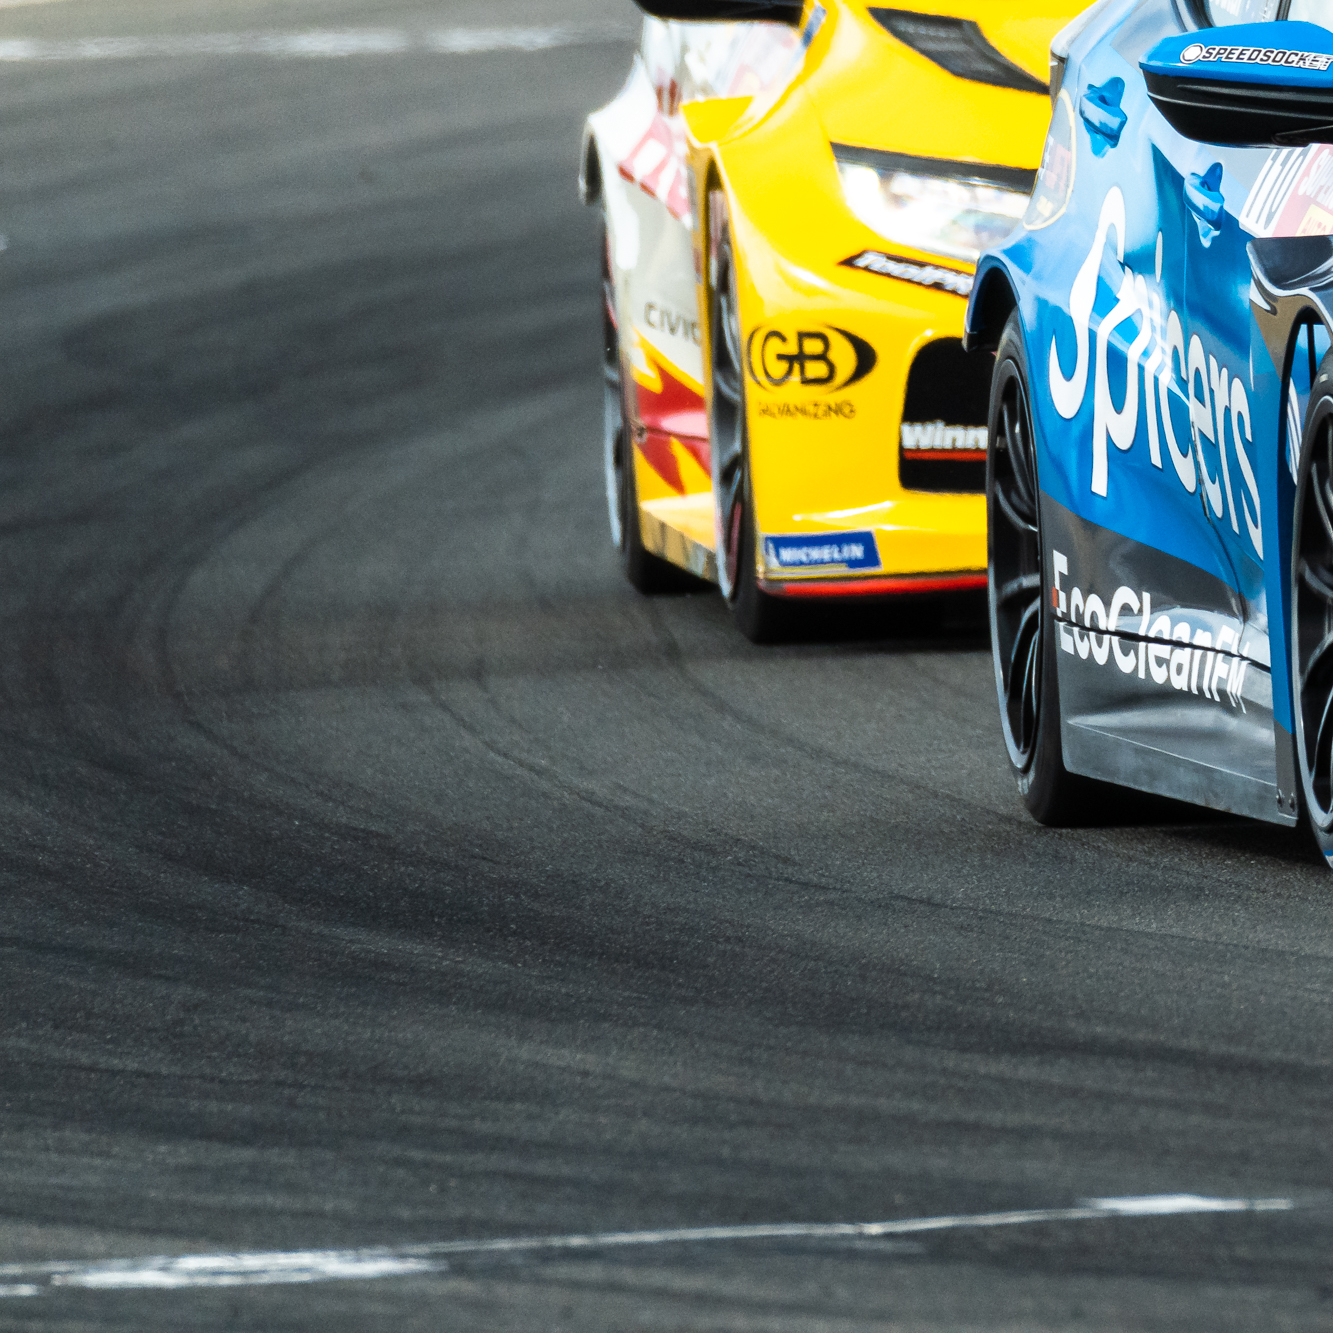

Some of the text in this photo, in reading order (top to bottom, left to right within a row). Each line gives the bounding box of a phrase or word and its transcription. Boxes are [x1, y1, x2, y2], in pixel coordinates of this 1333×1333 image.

[854, 250, 974, 297] ToolPR
[761, 329, 837, 387] GB
[1048, 185, 1265, 562] Spicers
[900, 419, 989, 449] Winn
[1052, 549, 1250, 714] EcoCleanFM
